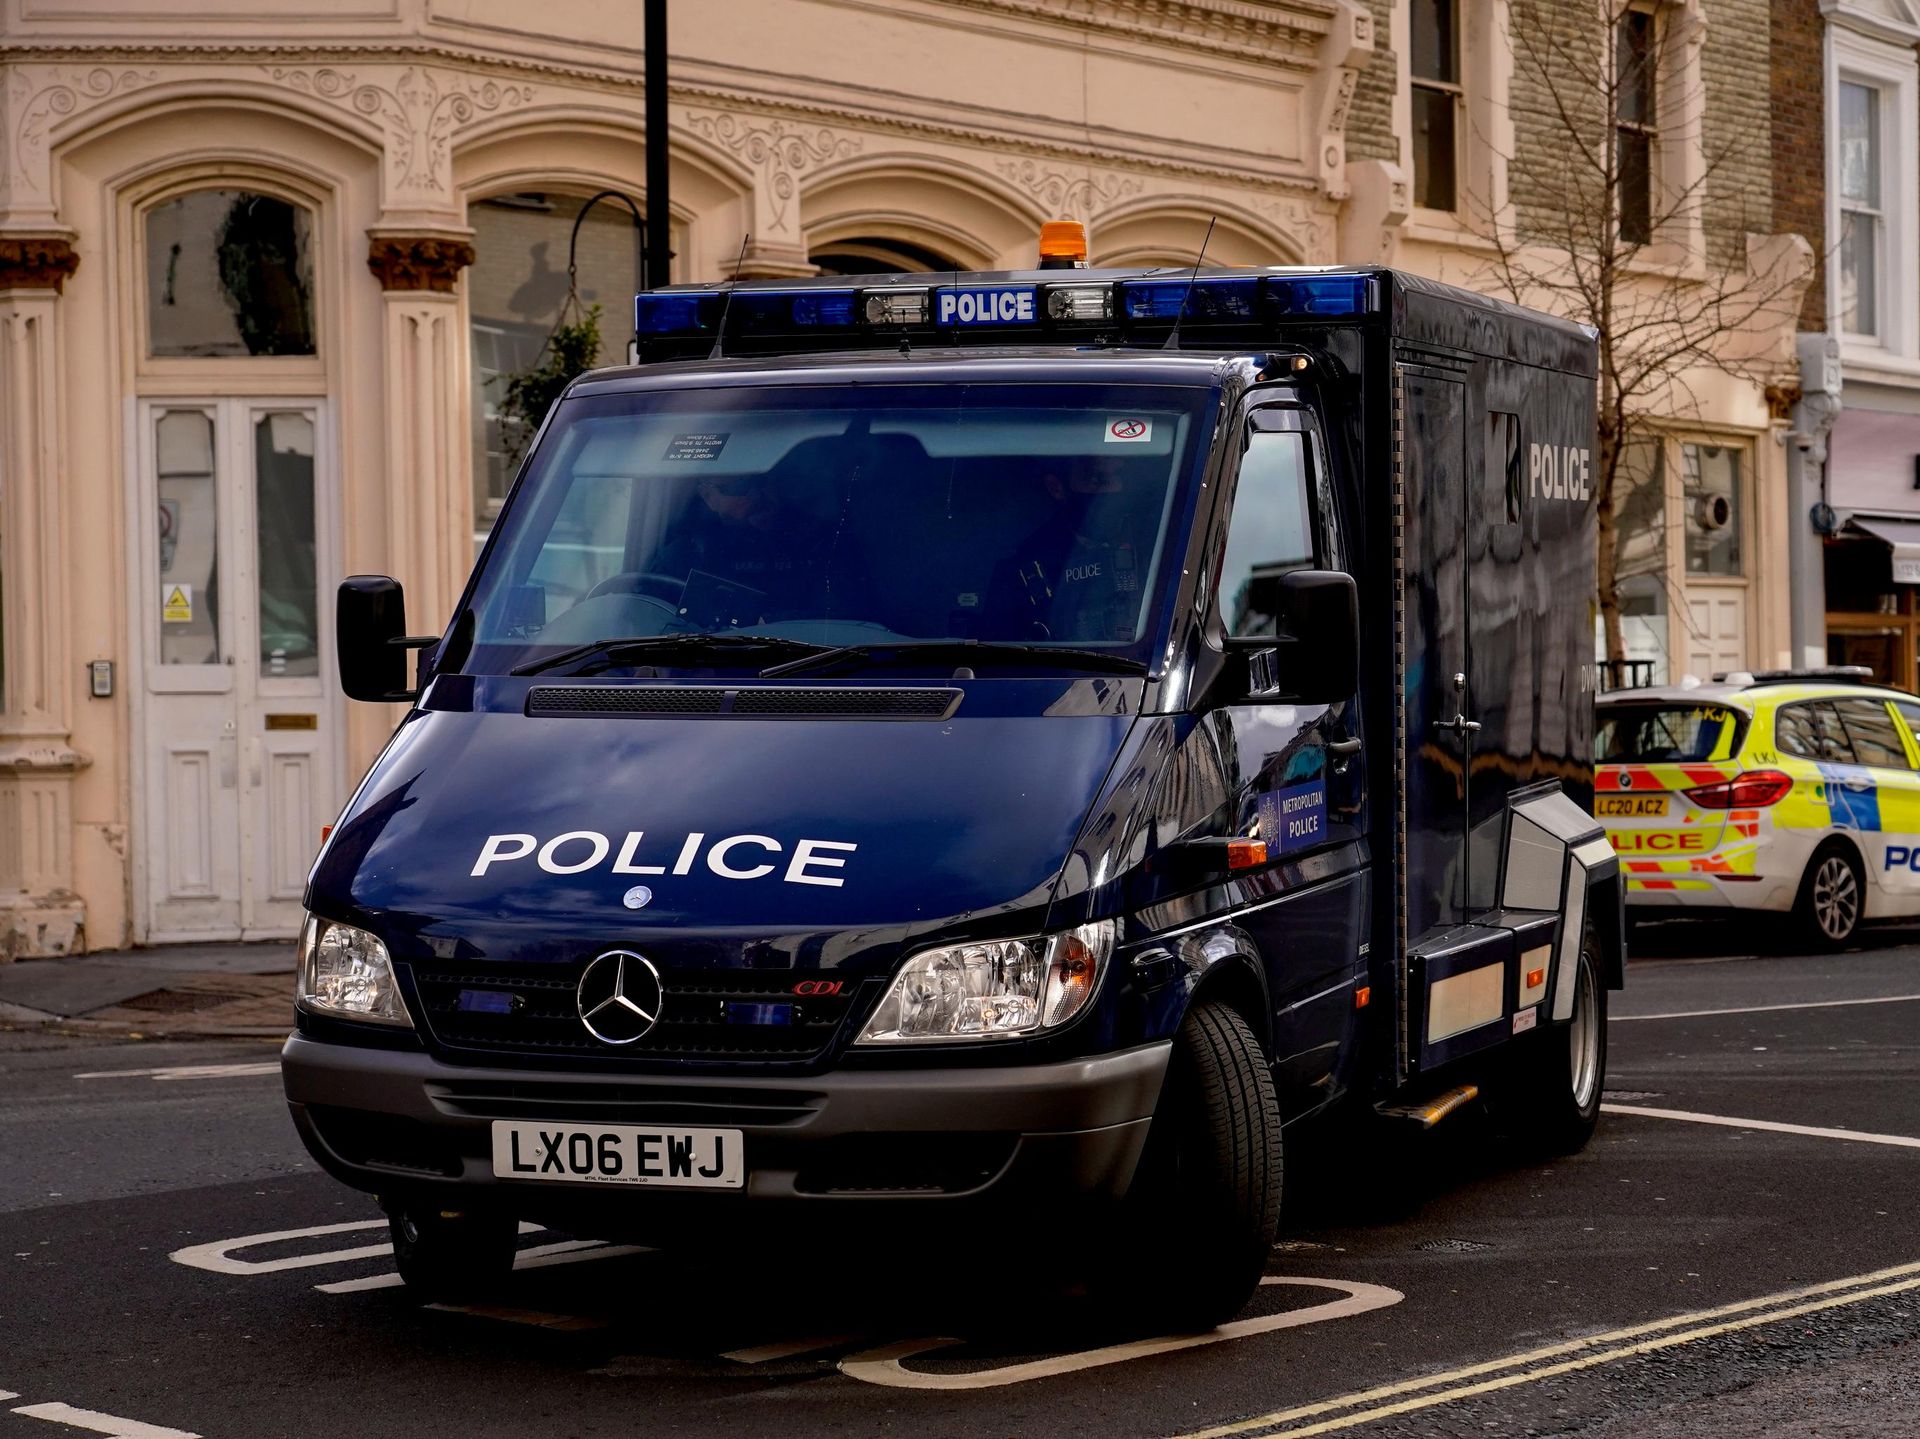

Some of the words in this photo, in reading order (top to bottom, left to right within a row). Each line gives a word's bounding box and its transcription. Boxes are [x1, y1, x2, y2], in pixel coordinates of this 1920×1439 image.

[941, 292, 1033, 322] POLICE
[1530, 443, 1590, 501] POLICE
[1065, 562, 1101, 583] POLICE
[1282, 790, 1323, 814] METROPOLITAN
[1598, 800, 1633, 815] LC20
[1636, 800, 1664, 814] ACZ
[1289, 815, 1318, 839] POLICE
[470, 831, 857, 887] POLICE
[792, 980, 844, 997] CDI
[510, 1130, 623, 1176] LX06
[636, 1134, 724, 1178] EWJ
